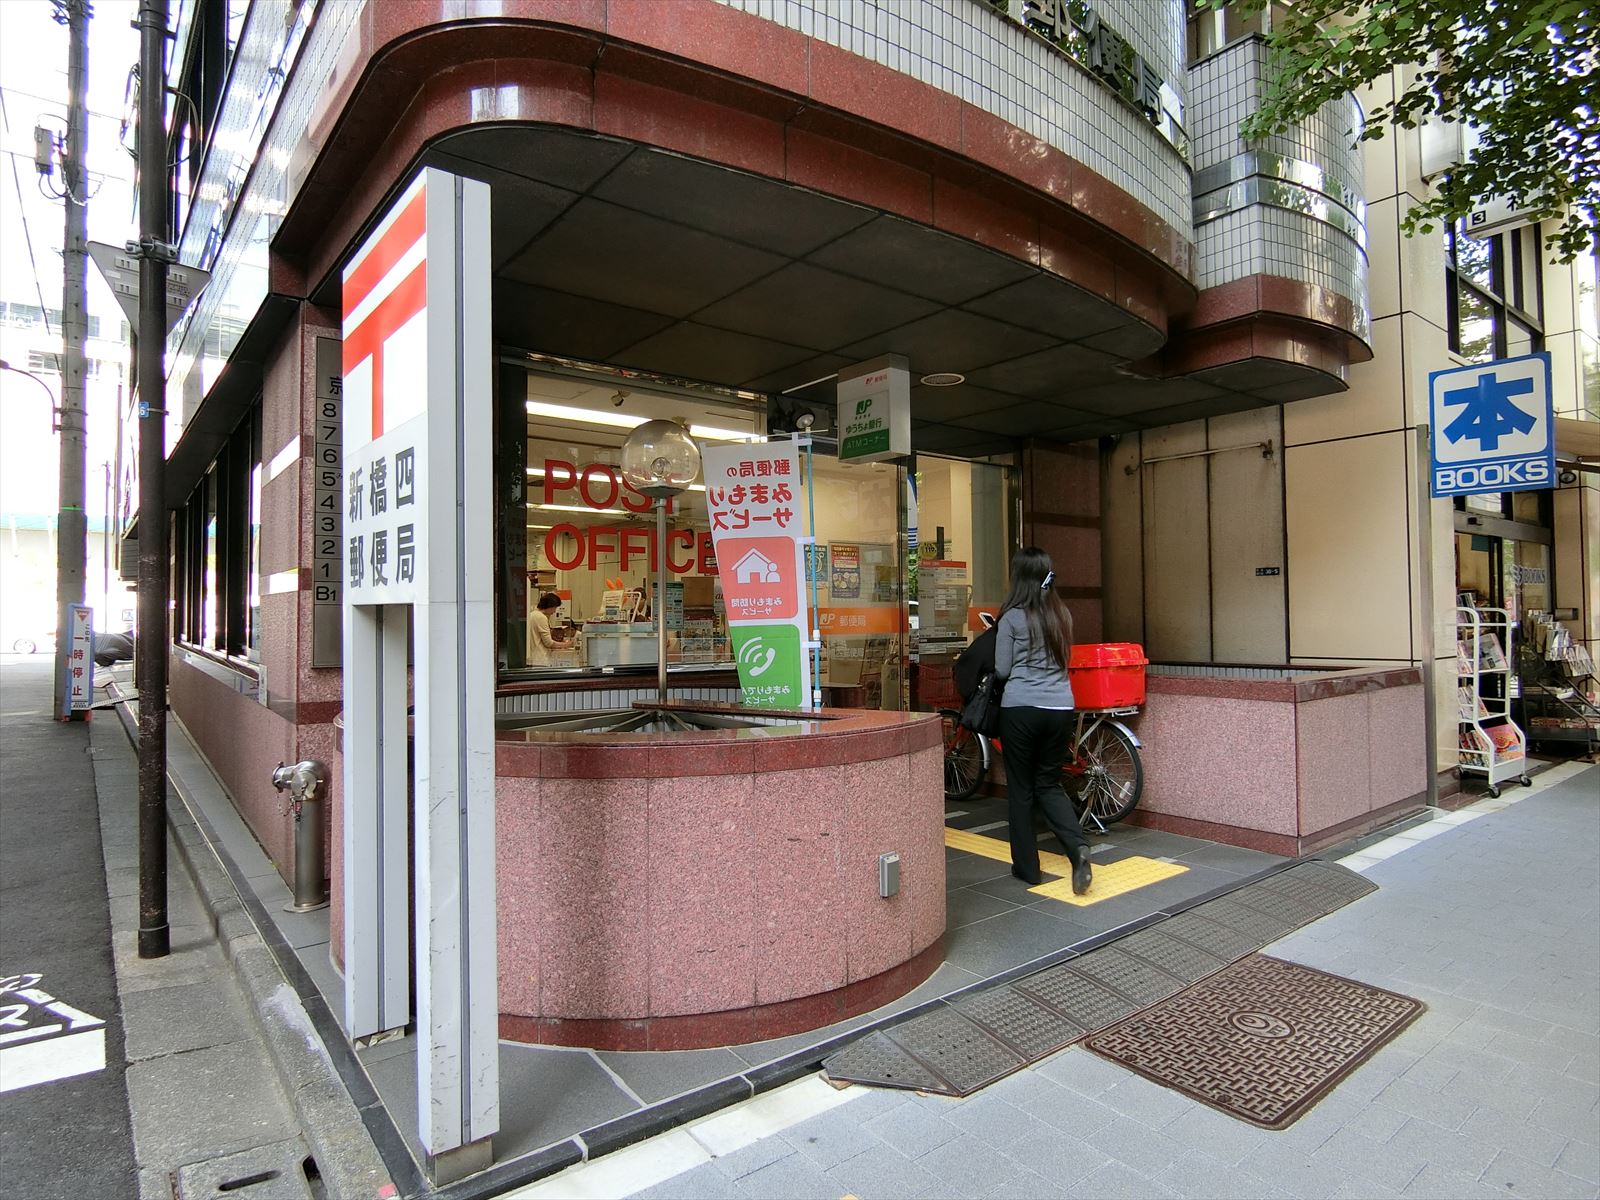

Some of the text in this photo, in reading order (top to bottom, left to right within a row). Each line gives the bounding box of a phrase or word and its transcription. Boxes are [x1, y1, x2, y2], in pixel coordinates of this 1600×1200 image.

[1473, 213, 1484, 223] 3
[322, 402, 337, 418] 8
[1443, 372, 1537, 451] 本
[322, 425, 337, 441] 7
[845, 418, 882, 434] ゆうちょ銀行
[846, 435, 886, 449] ATMコーナー
[323, 448, 337, 464] 6
[322, 471, 336, 487] 5
[1436, 460, 1548, 490] BOOKS
[349, 446, 415, 523] 新橋四
[320, 494, 335, 510] 4
[321, 517, 335, 532] 3
[321, 539, 336, 555] 2
[350, 522, 416, 588] 郵便局
[321, 563, 330, 578] 1
[316, 586, 337, 601] B1
[72, 636, 84, 696] 一時停止
